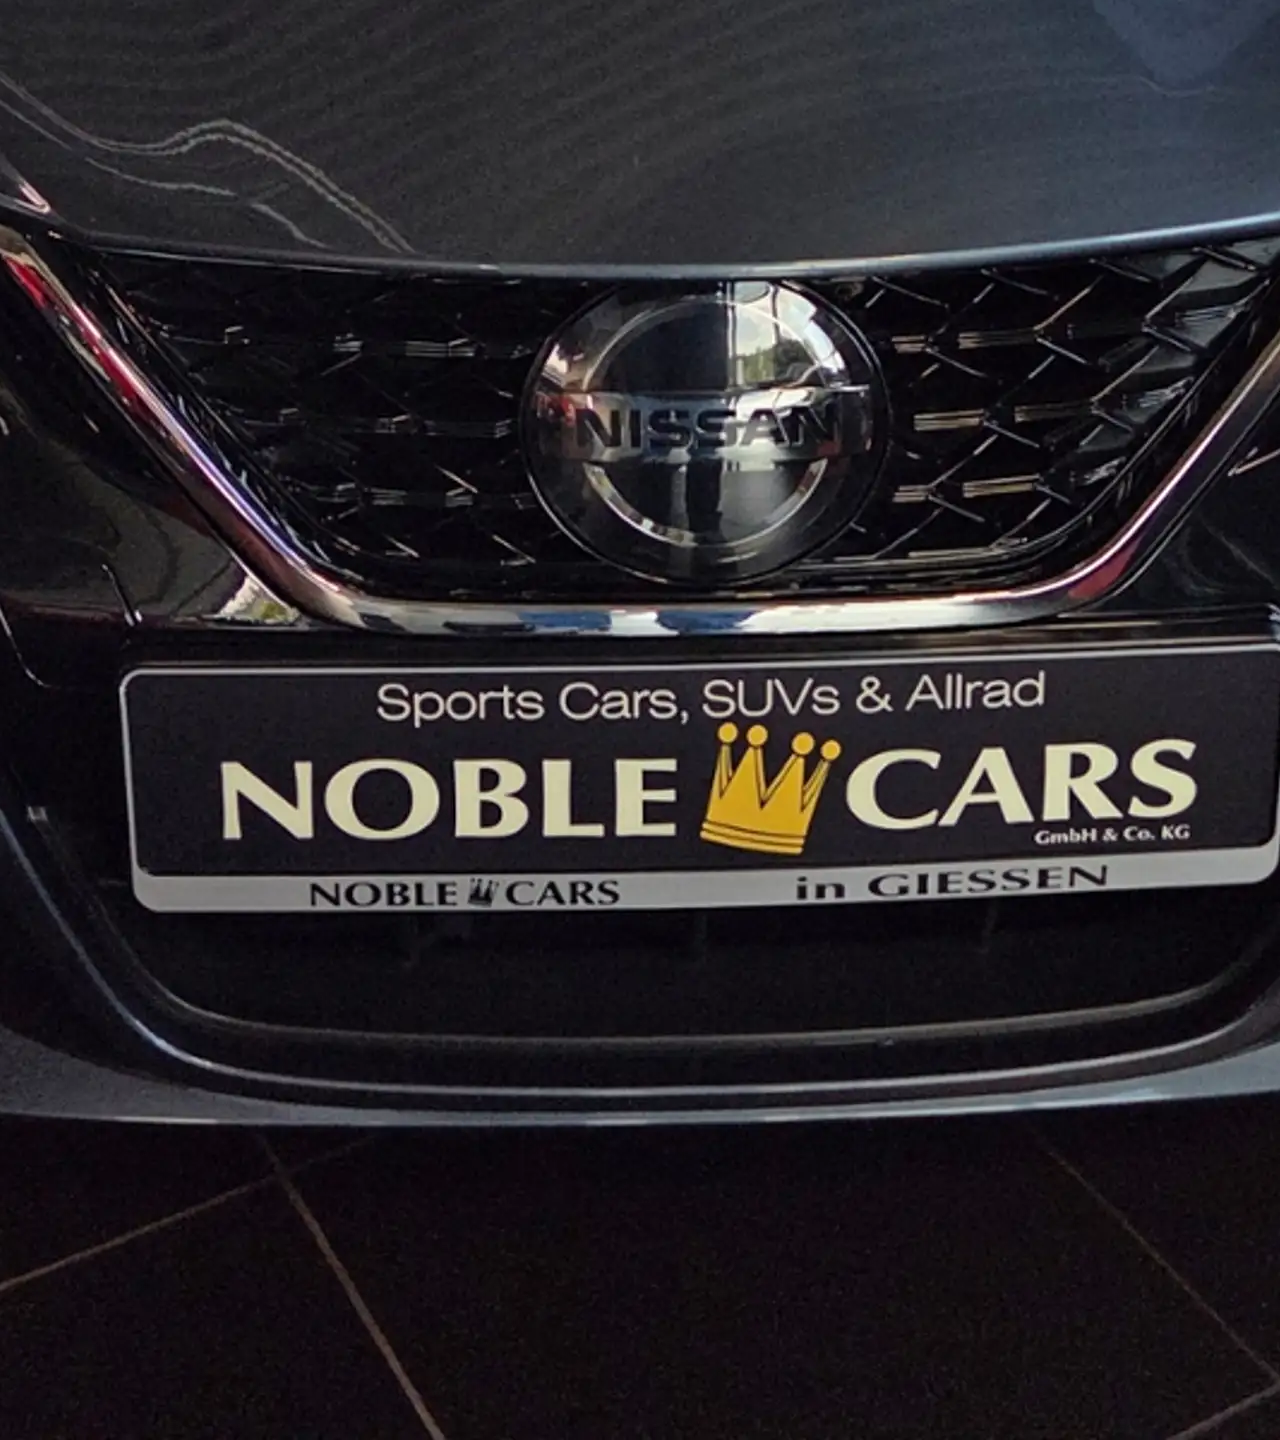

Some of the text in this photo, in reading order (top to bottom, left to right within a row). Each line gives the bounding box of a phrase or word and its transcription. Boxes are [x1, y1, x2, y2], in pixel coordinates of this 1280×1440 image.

[574, 406, 842, 450] NISSAN
[376, 669, 1046, 729] Sports Cars, SUVs & Allrad
[220, 738, 1199, 842] NOBLE CARS
[1033, 823, 1192, 846] GmbH & Co. KG
[308, 878, 621, 909] NOBLE CARS
[795, 863, 1109, 902] in GIESSEN
